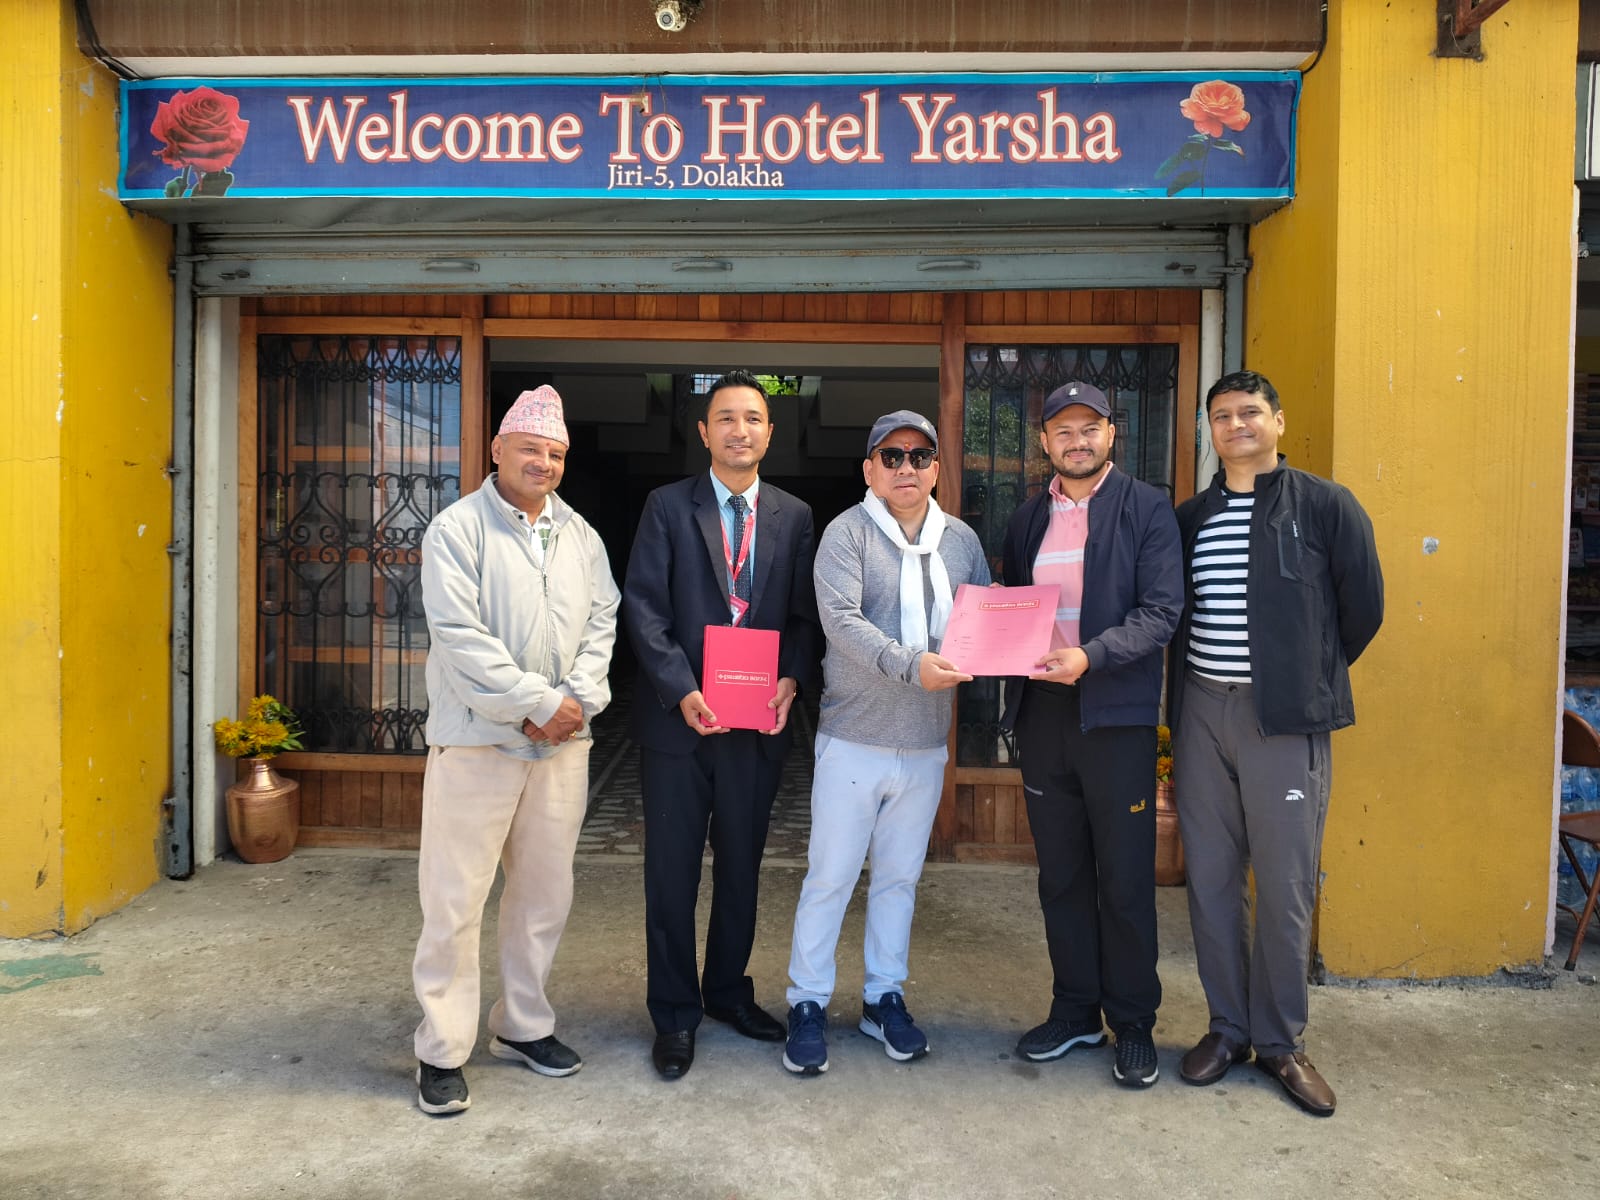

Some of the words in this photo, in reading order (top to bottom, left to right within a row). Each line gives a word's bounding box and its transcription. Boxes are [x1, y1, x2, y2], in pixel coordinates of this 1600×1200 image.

[287, 90, 584, 164] Welcome
[599, 92, 684, 165] To
[701, 90, 884, 165] Hotel
[899, 87, 1122, 164] Yarsha
[607, 163, 675, 190] Jiri-5,
[681, 163, 785, 187] Dolakha
